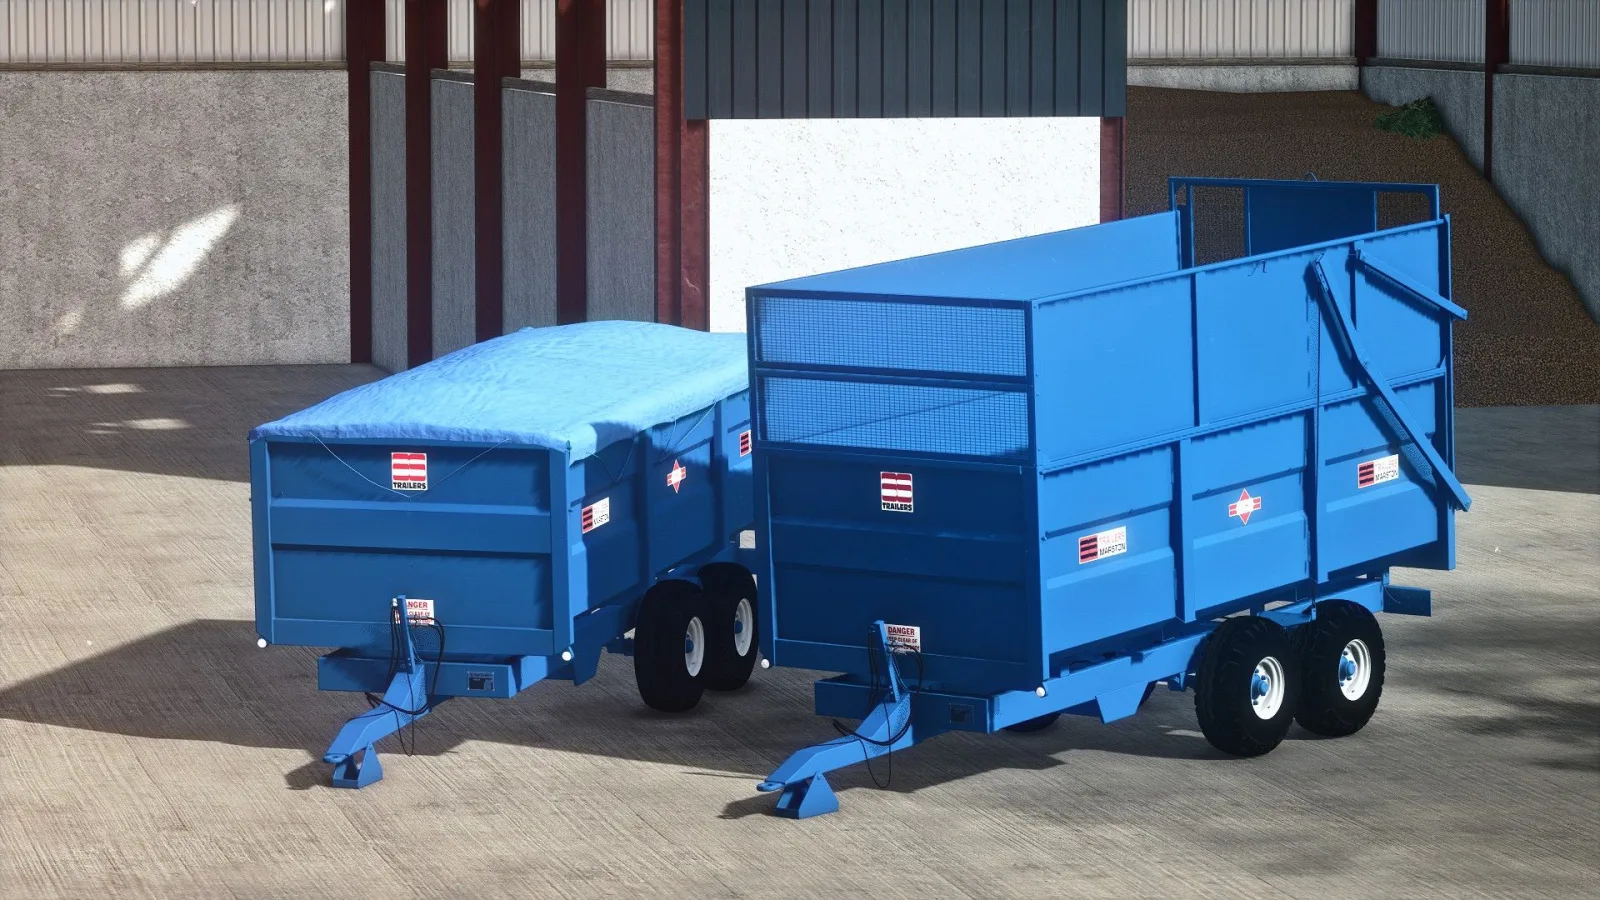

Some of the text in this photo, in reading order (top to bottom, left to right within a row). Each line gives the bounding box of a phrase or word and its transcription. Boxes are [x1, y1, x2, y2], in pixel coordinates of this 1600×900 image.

[882, 502, 912, 511] TRAILERS
[1099, 543, 1126, 556] MARSTON
[887, 626, 915, 635] DANGER
